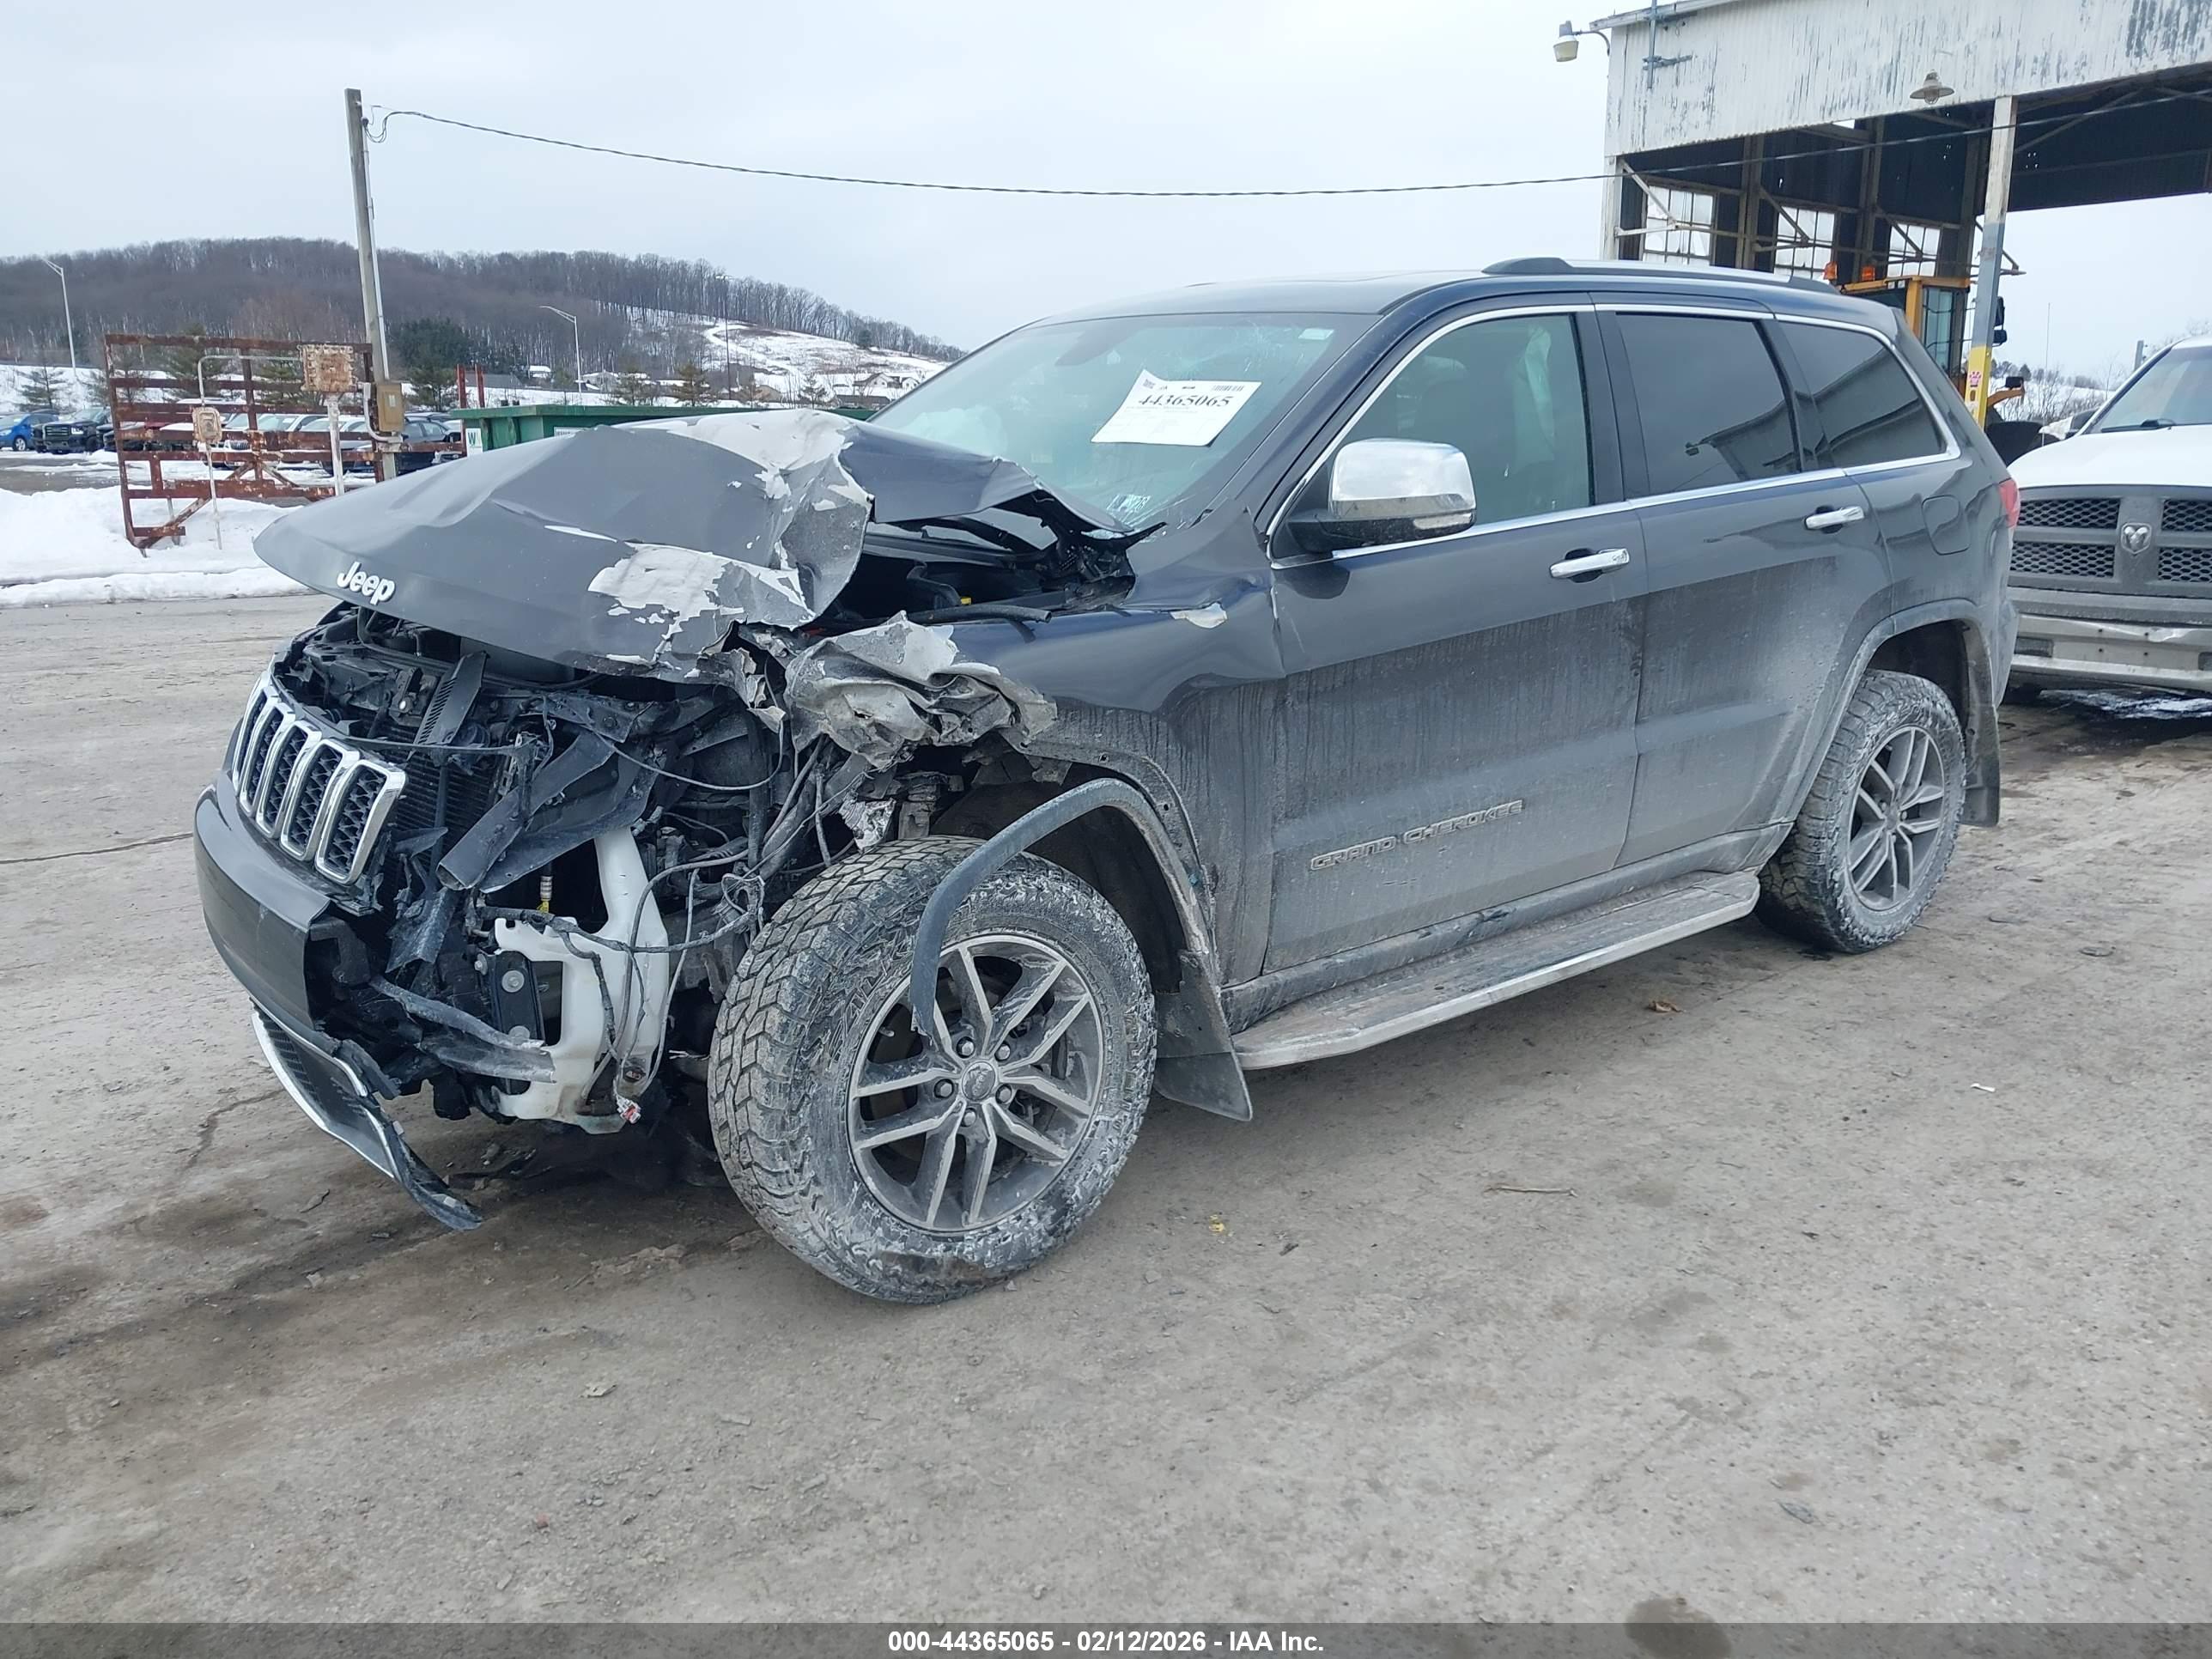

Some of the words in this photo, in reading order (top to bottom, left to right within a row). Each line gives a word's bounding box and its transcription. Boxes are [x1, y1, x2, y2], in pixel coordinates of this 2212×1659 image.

[1138, 393, 1235, 407] 44365065
[337, 561, 396, 605] Jeep
[1310, 836, 1397, 870] GRAND
[1403, 799, 1524, 845] CHEROKEE
